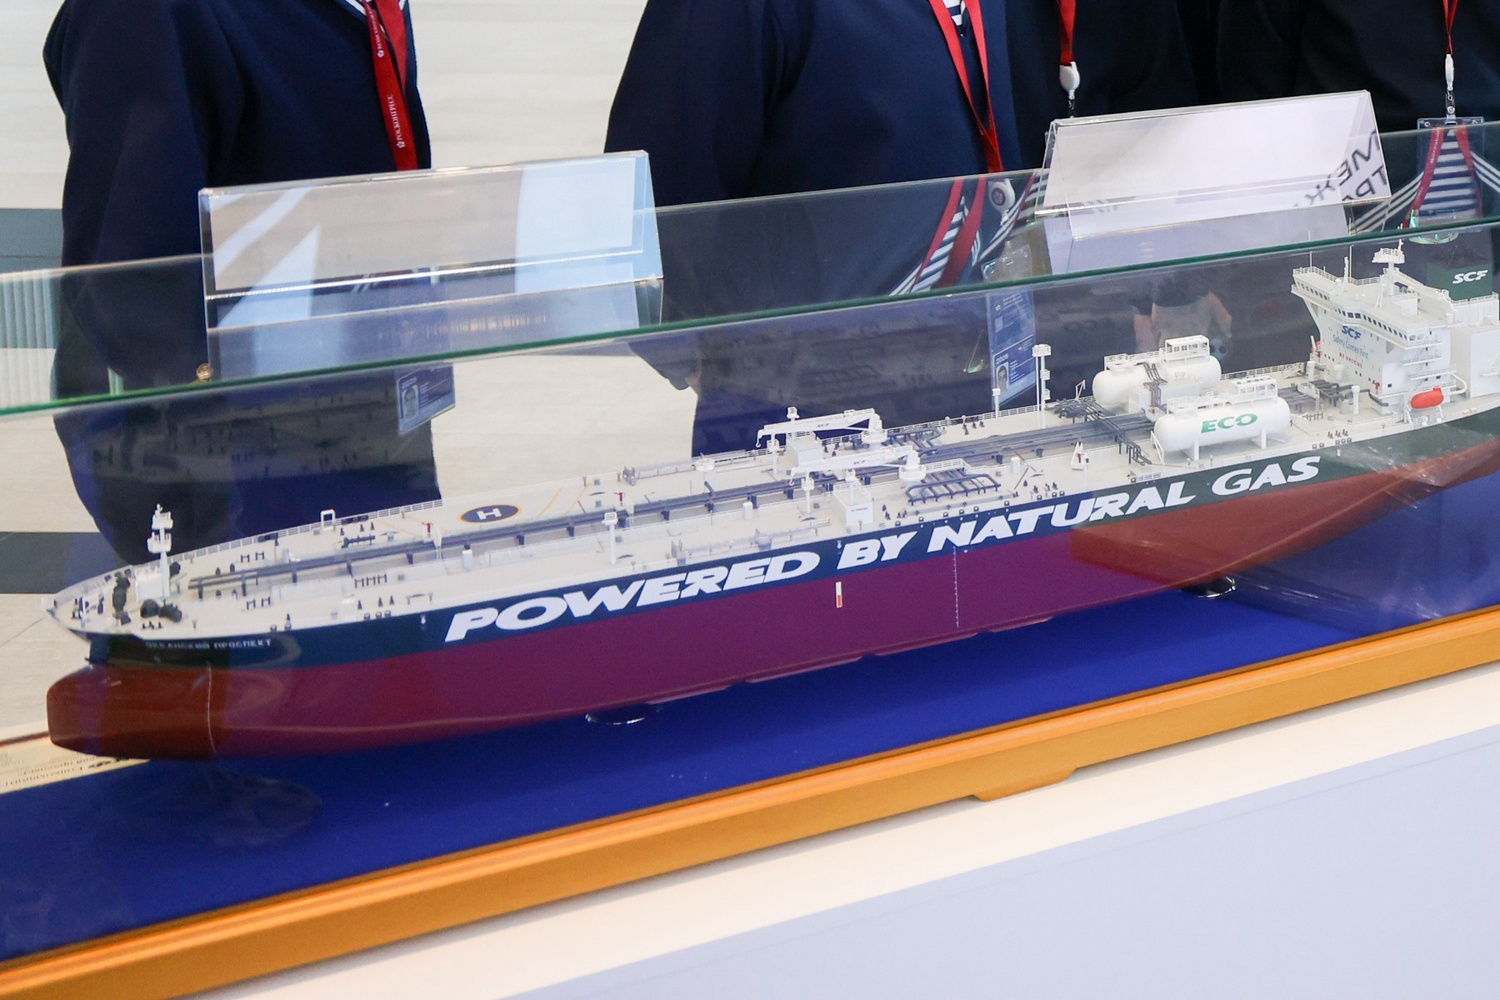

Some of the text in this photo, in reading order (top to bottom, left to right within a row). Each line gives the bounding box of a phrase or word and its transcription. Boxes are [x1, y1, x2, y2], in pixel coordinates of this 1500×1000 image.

[1452, 269, 1488, 284] SCF
[1341, 325, 1361, 340] SCF
[1201, 413, 1258, 434] ECO
[477, 506, 503, 521] H
[444, 456, 1321, 642] POWERED BY NATURAL GAS
